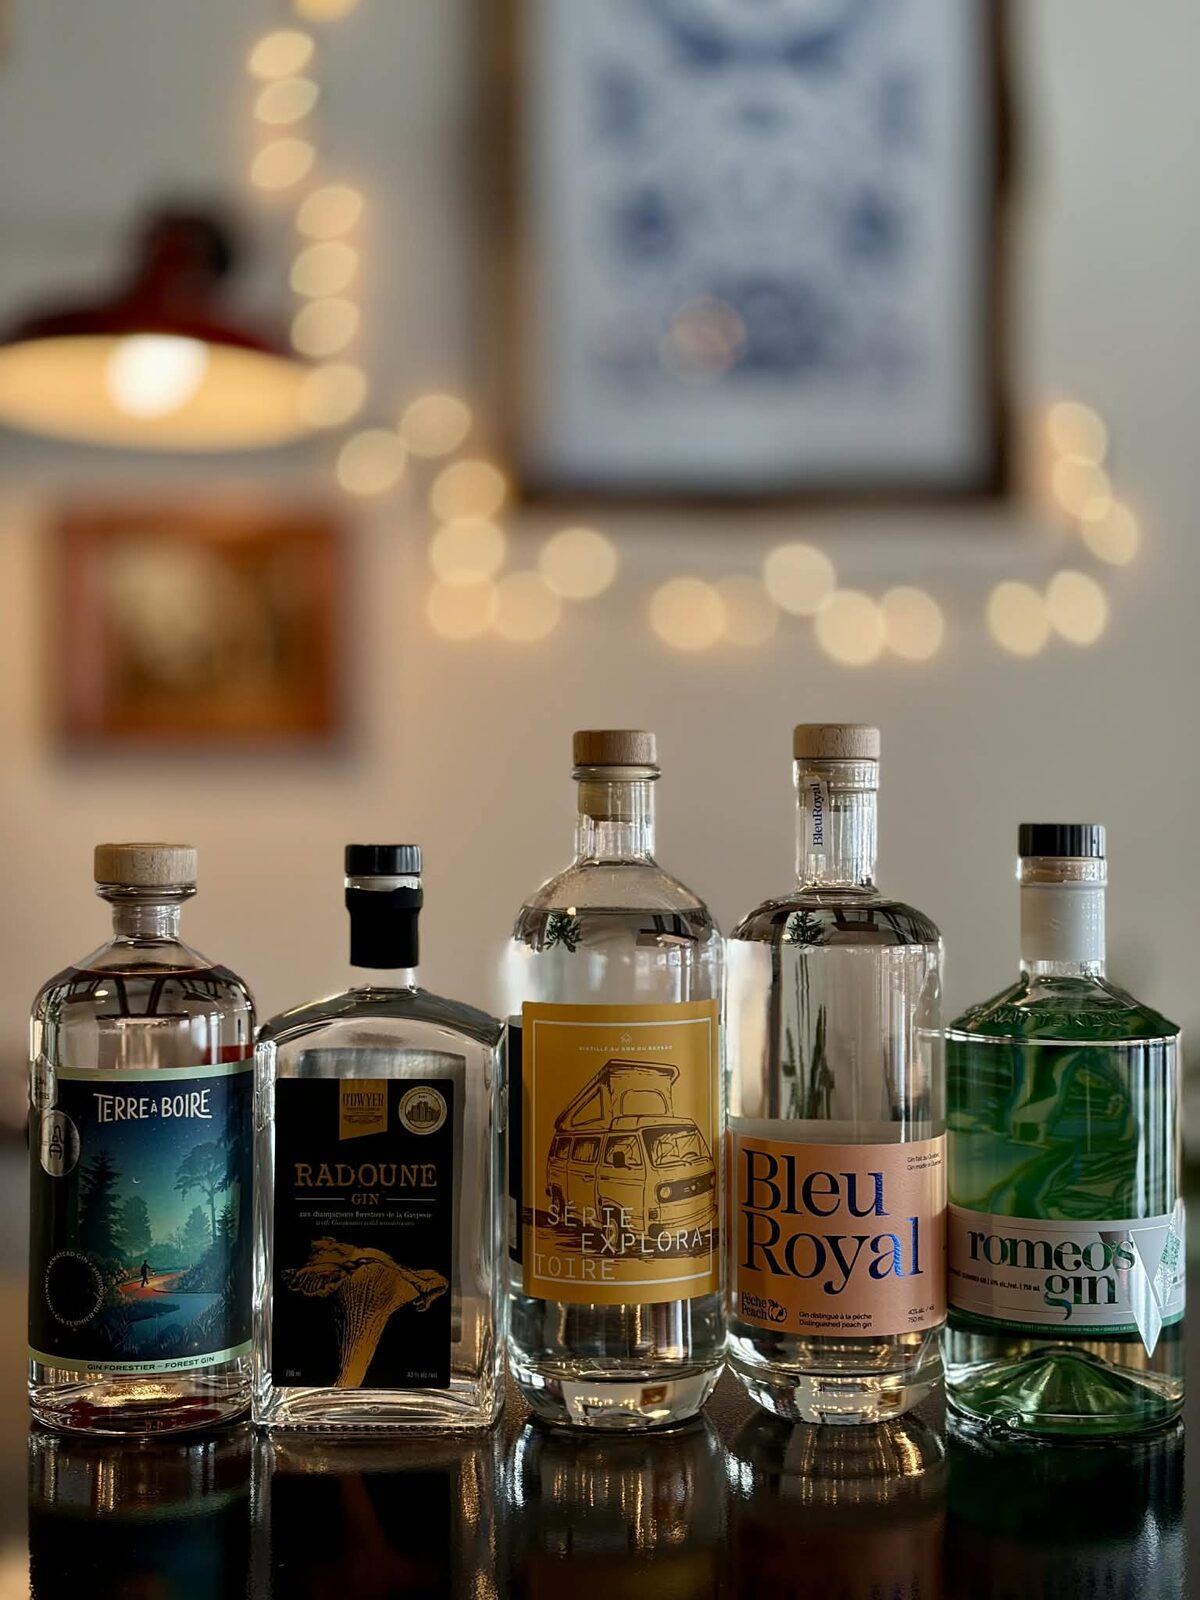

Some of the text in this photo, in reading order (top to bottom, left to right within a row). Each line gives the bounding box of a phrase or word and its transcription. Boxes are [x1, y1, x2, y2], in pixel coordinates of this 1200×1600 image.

[810, 783, 824, 846] BleuRoyal
[93, 1093, 150, 1123] TERRE
[161, 1089, 213, 1119] BOIRE
[294, 1163, 438, 1188] RADOUNE
[741, 1148, 890, 1218] Bleu
[351, 1193, 380, 1205] GIN
[547, 1200, 634, 1228] SÉRIE
[741, 1209, 924, 1295] Royal
[535, 1253, 615, 1280] TOIRE
[1044, 1274, 1119, 1321] gin
[741, 1303, 768, 1320] Peach
[799, 1311, 809, 1319] Gin
[810, 1312, 839, 1321] distingué
[799, 1319, 840, 1328] Distinguished
[862, 1321, 872, 1329] gin
[87, 1356, 215, 1371] GIN FORESTIER FOREST GIN
